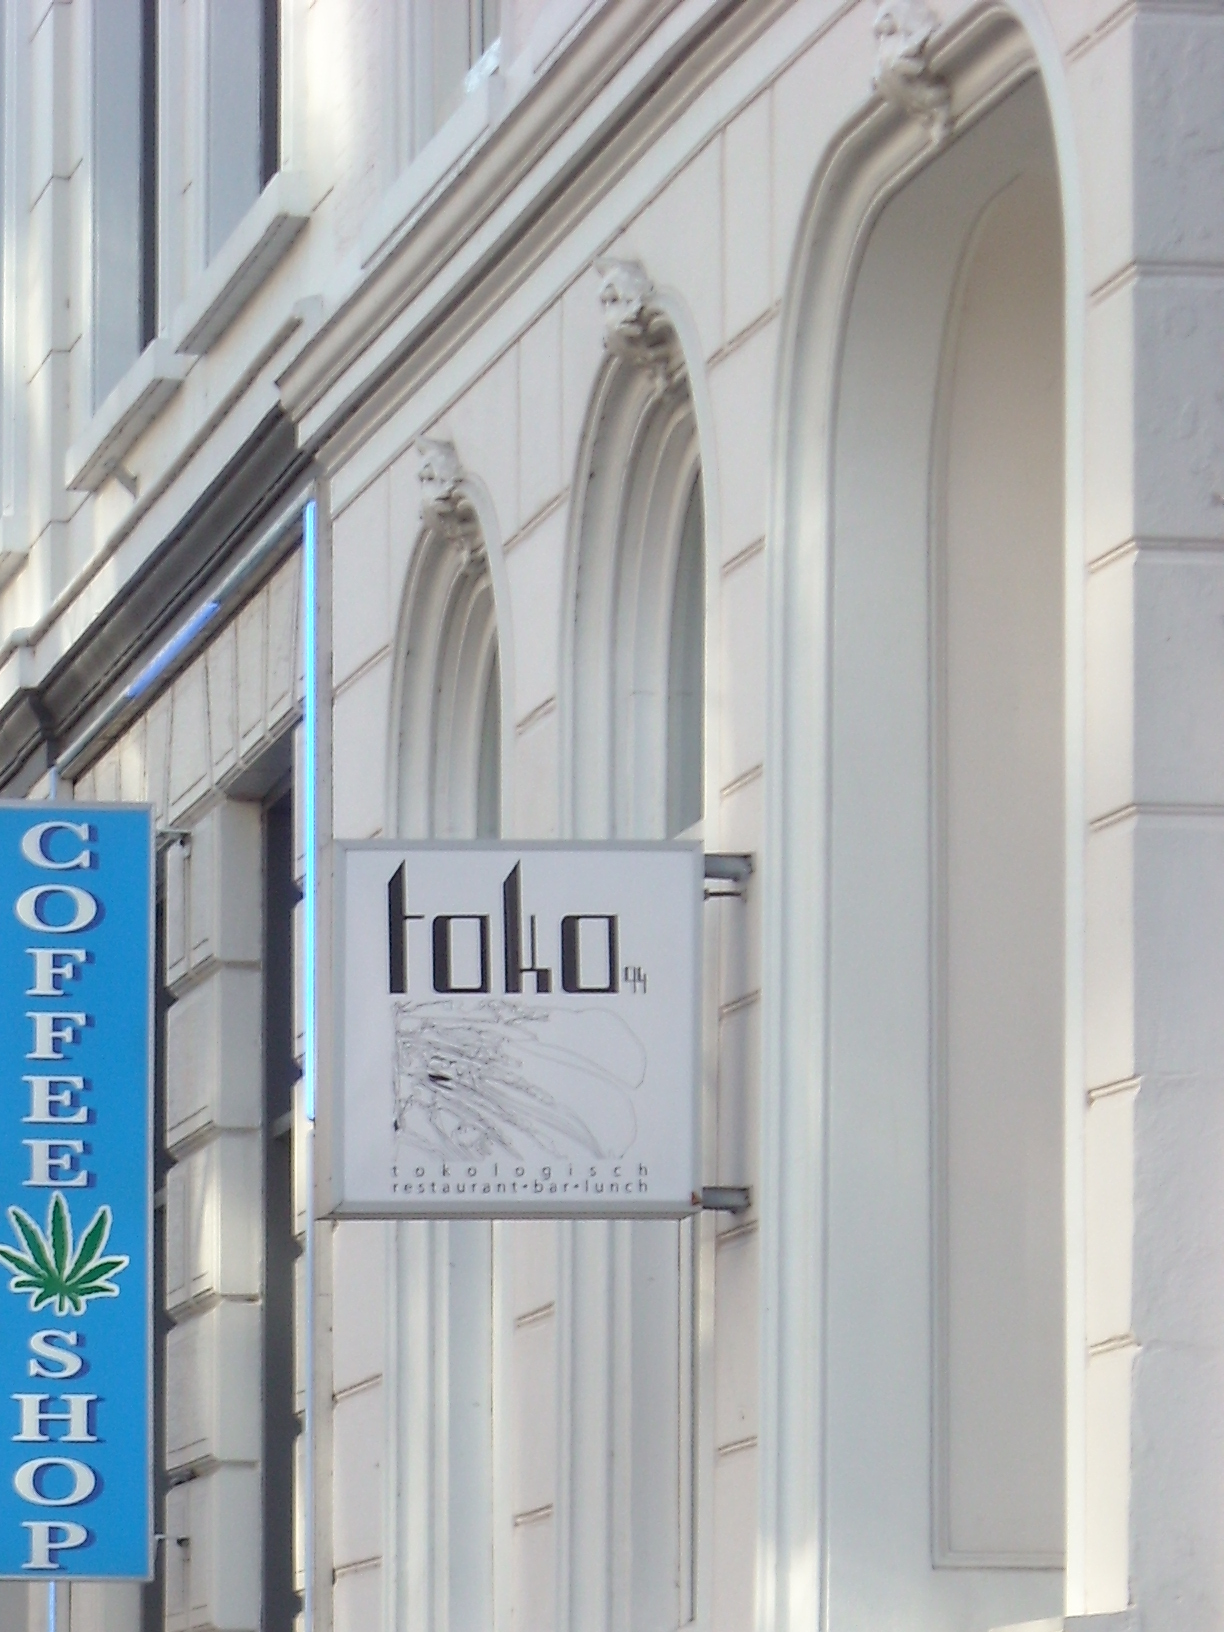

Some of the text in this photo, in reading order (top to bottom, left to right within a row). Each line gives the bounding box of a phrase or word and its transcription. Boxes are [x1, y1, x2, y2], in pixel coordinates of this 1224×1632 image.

[15, 820, 103, 1190] COFFEE
[387, 859, 619, 994] toko
[391, 1163, 648, 1180] tokologisch
[12, 1329, 102, 1571] SHOP
